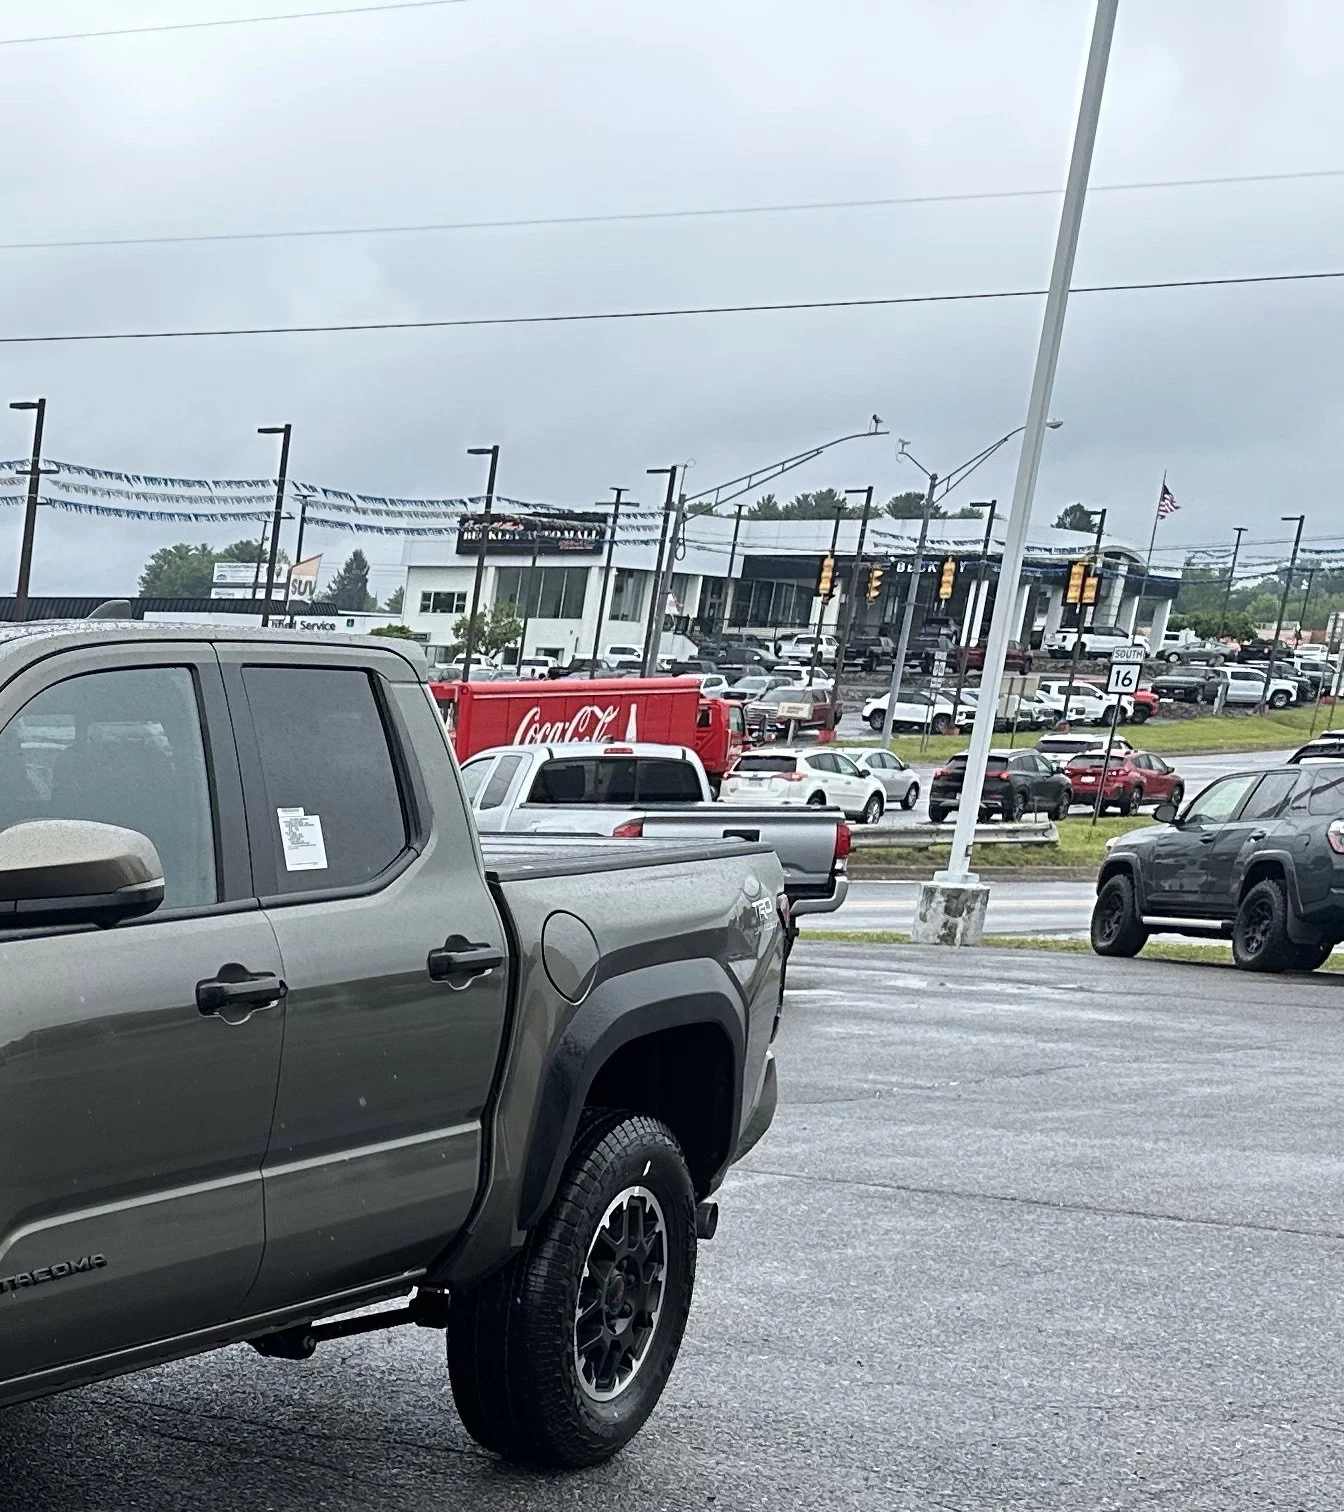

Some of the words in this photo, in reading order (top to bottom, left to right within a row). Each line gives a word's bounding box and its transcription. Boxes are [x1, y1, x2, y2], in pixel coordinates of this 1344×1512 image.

[291, 578, 316, 597] SUV
[300, 620, 336, 631] Service
[1114, 650, 1143, 659] SOUTH
[1115, 670, 1133, 687] 16
[752, 896, 773, 921] TRD
